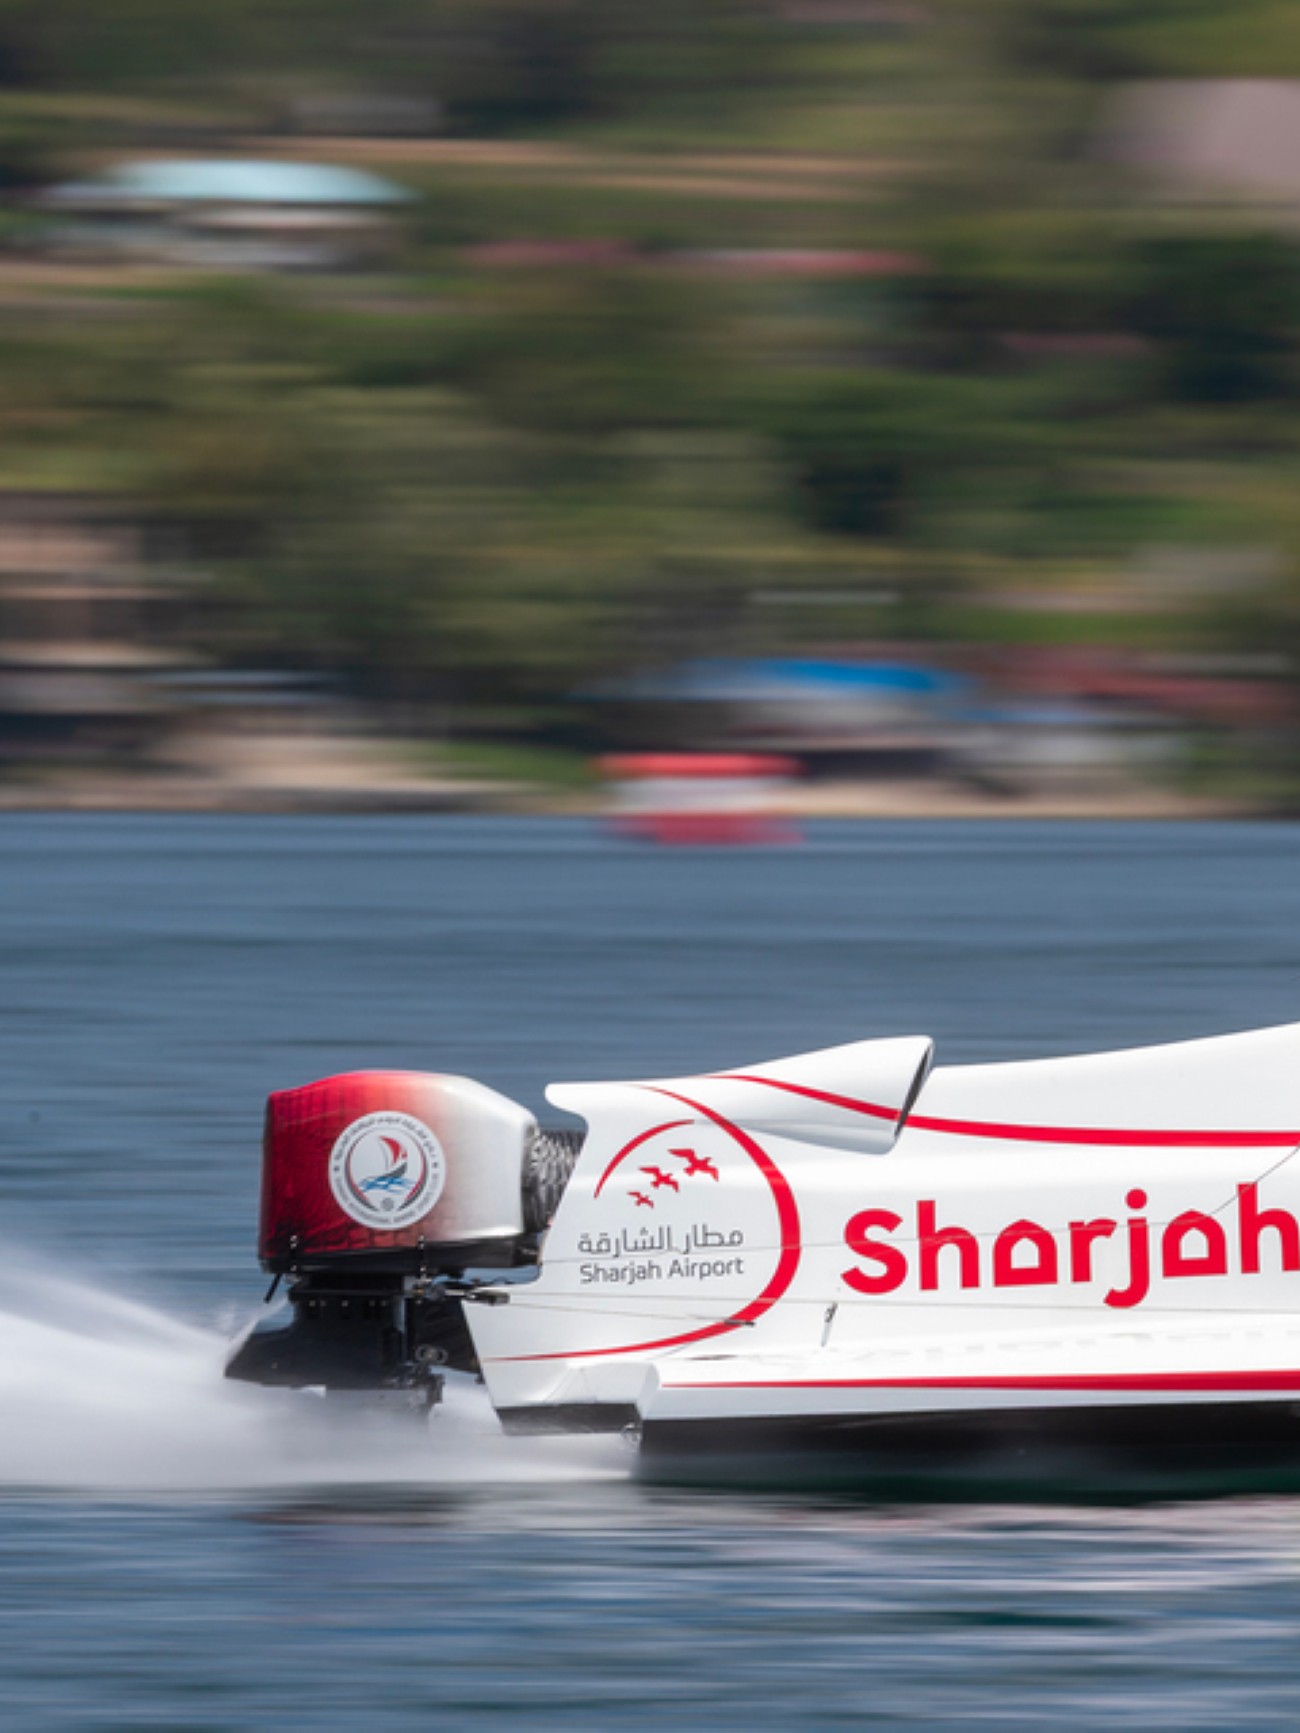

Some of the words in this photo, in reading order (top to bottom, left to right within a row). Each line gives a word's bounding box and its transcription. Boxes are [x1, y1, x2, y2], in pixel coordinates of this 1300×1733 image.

[577, 1225, 671, 1258] الشارقة
[680, 1224, 744, 1255] مطار
[579, 1260, 662, 1284] Sharjah
[667, 1257, 744, 1280] Airport
